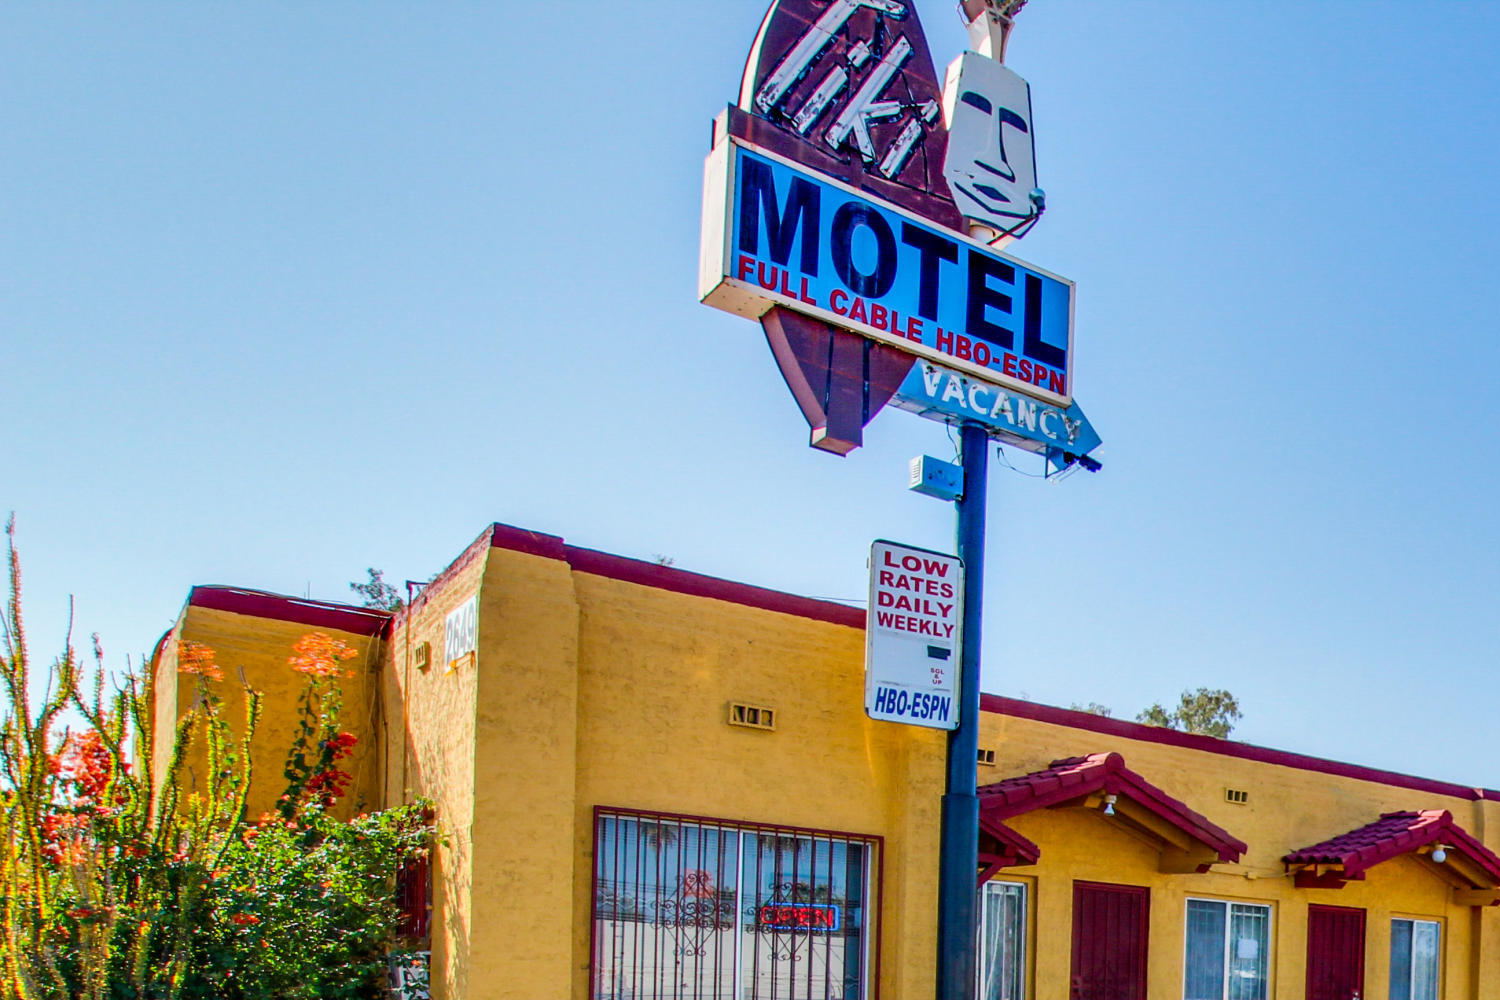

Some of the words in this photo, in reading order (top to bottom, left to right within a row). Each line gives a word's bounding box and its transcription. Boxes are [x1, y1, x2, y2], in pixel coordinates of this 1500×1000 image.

[738, 154, 1066, 371] MOTEL
[738, 254, 817, 307] FULL
[829, 288, 924, 344] CABLE
[936, 327, 1067, 397] HBO-ESPN
[921, 363, 1082, 446] VACANCY
[884, 551, 949, 577] LOW
[879, 570, 954, 598] RATES
[878, 590, 954, 618] DAILY
[877, 611, 955, 638] WEEKLY
[875, 686, 951, 722] HBO-ESPN
[761, 906, 835, 927] OPEN
